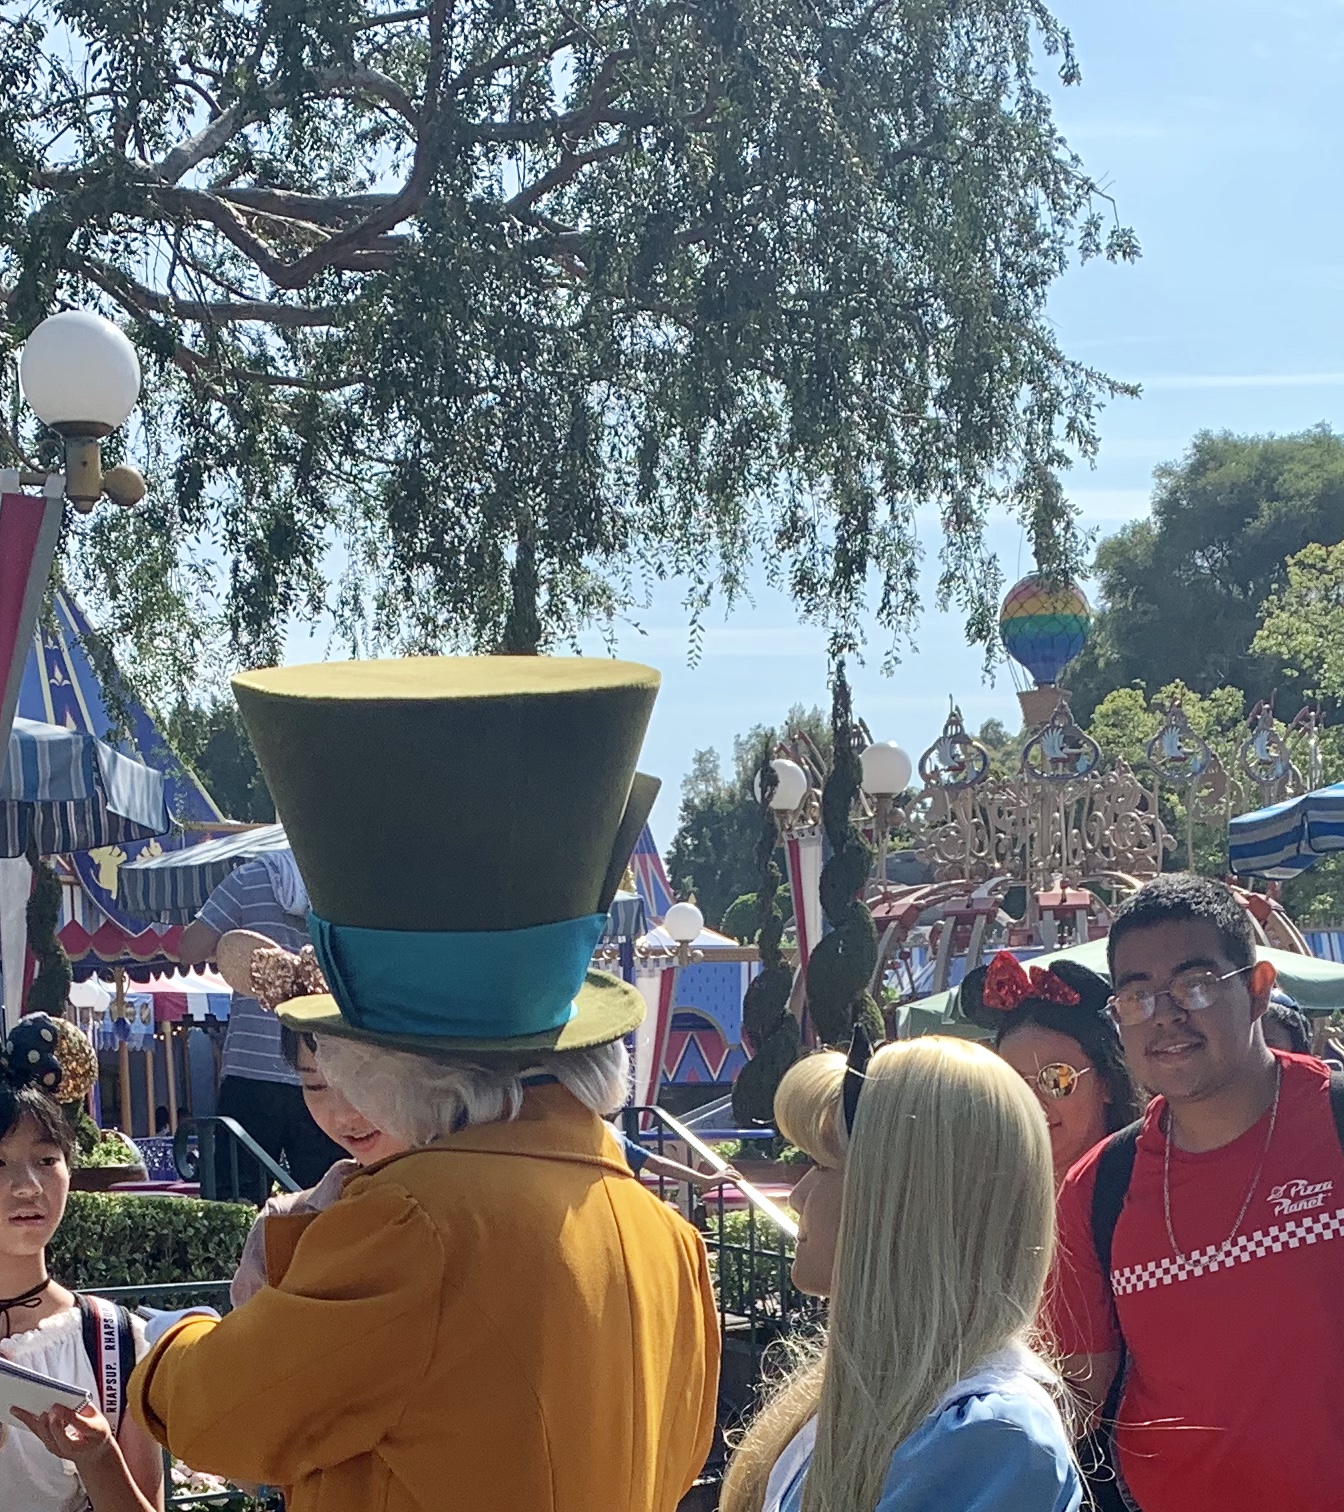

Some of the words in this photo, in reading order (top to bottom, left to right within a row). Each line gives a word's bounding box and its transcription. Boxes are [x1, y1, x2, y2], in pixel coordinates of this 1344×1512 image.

[1285, 1180, 1334, 1197] Pizza
[1270, 1195, 1327, 1217] Planet
[106, 1362, 117, 1413] RHAPSUP.
